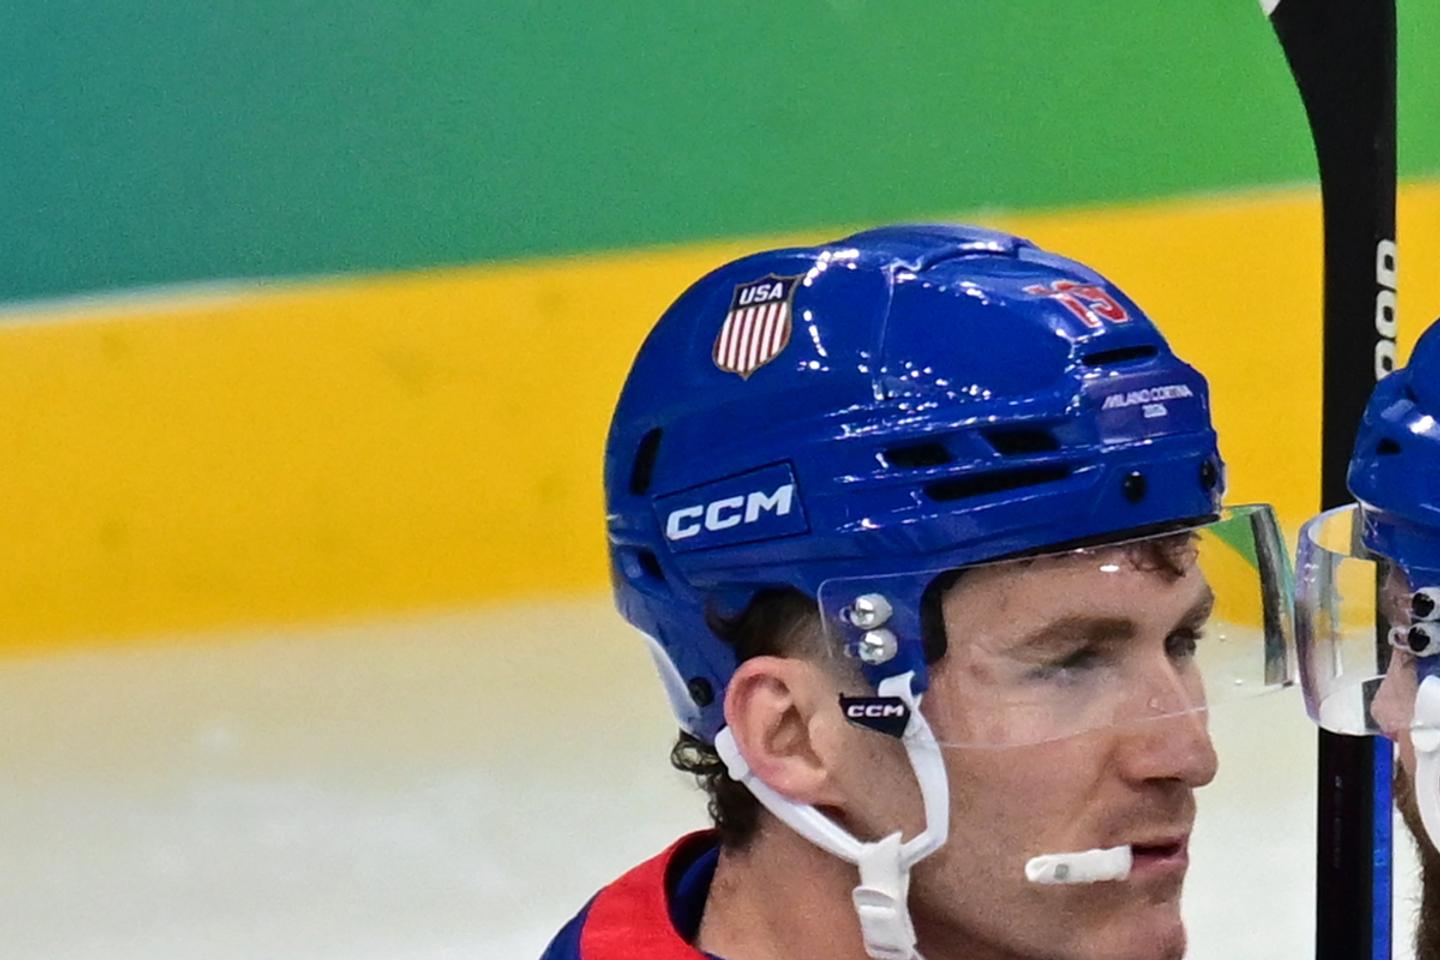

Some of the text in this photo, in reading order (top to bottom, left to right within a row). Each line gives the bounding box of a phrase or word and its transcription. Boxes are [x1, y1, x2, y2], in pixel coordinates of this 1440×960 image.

[739, 282, 783, 305] USA
[666, 484, 793, 541] CCM
[847, 704, 904, 718] CCM
